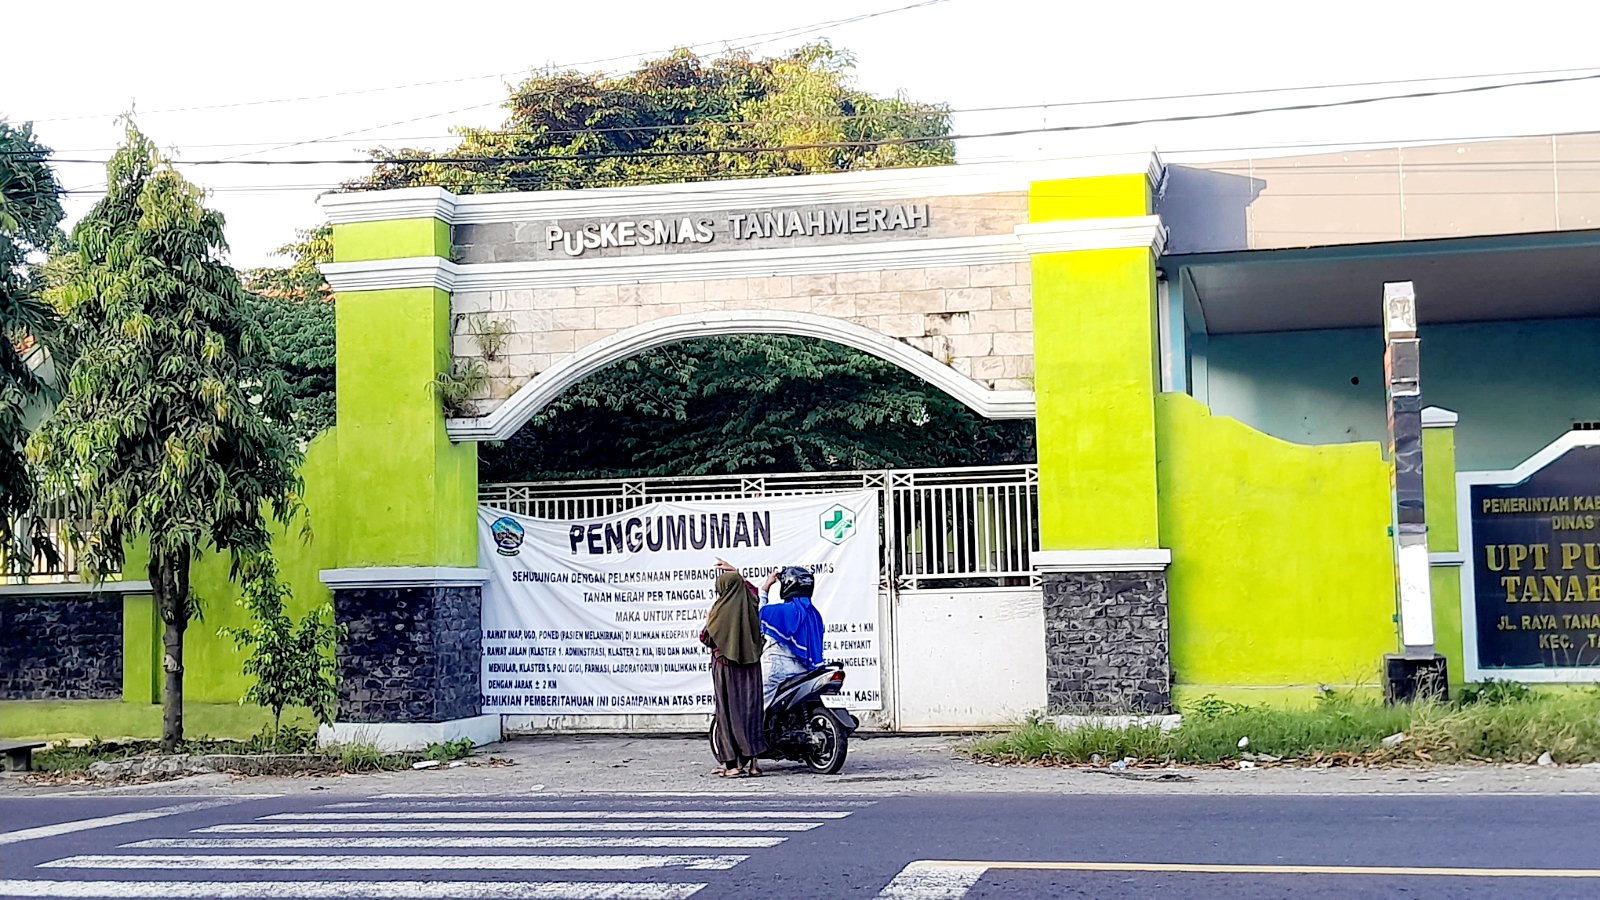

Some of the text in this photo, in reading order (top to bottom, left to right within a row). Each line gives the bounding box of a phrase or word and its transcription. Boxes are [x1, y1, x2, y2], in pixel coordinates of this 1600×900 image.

[545, 204, 929, 257] PUSKESMAS TANAHMERAH
[1483, 496, 1568, 513] PEMERINTAH
[1552, 515, 1594, 530] DINAS
[569, 511, 771, 555] PENGUMUMAN
[1485, 543, 1549, 571] UPT
[512, 571, 568, 583] SEHUBUNGAN
[572, 572, 606, 584] DENGAN
[608, 571, 670, 583] PELAKSANAAN
[583, 592, 612, 602] TANAH
[614, 591, 644, 602] MERAH
[647, 591, 664, 601] PER
[666, 590, 706, 600] TANGGAL
[615, 609, 708, 622] MAKA UNTUK PELAYA
[1497, 616, 1517, 630] JL.
[1522, 615, 1557, 630] RAYA
[487, 630, 506, 639] RAWAT
[539, 630, 560, 640] PONED
[626, 630, 632, 640] DI
[633, 630, 660, 640] ALIHKAN
[662, 630, 689, 639] KEDEPAN
[828, 623, 848, 633] JARAK
[864, 622, 874, 632] KM
[1539, 634, 1574, 648] KEC.
[487, 646, 507, 656] RAWAT
[508, 646, 527, 656] JALAN
[608, 647, 634, 656] KLASTER
[642, 647, 654, 658] KIA,
[656, 647, 666, 656] IBU
[668, 646, 680, 656] DAN
[682, 646, 700, 658] ANAK,
[840, 640, 871, 650] PENYAKIT
[519, 664, 546, 672] KLASTER
[553, 664, 566, 672] POLI
[569, 664, 583, 674] GIGI,
[584, 664, 611, 674] FARMASI,
[612, 664, 659, 673] LABORATORIUM
[664, 663, 697, 672] DIALIHKAN
[700, 662, 706, 672] KE
[488, 680, 512, 689] DENGAN
[514, 680, 532, 689] JARAK
[548, 680, 557, 689] KM
[481, 695, 522, 706] DEMIKIAN
[524, 695, 594, 706] PEMBERITAHUAN
[597, 696, 608, 706] INI
[612, 696, 670, 706] DISAMPAIKAN
[672, 695, 694, 706] ATAS
[854, 690, 880, 702] KASIH
